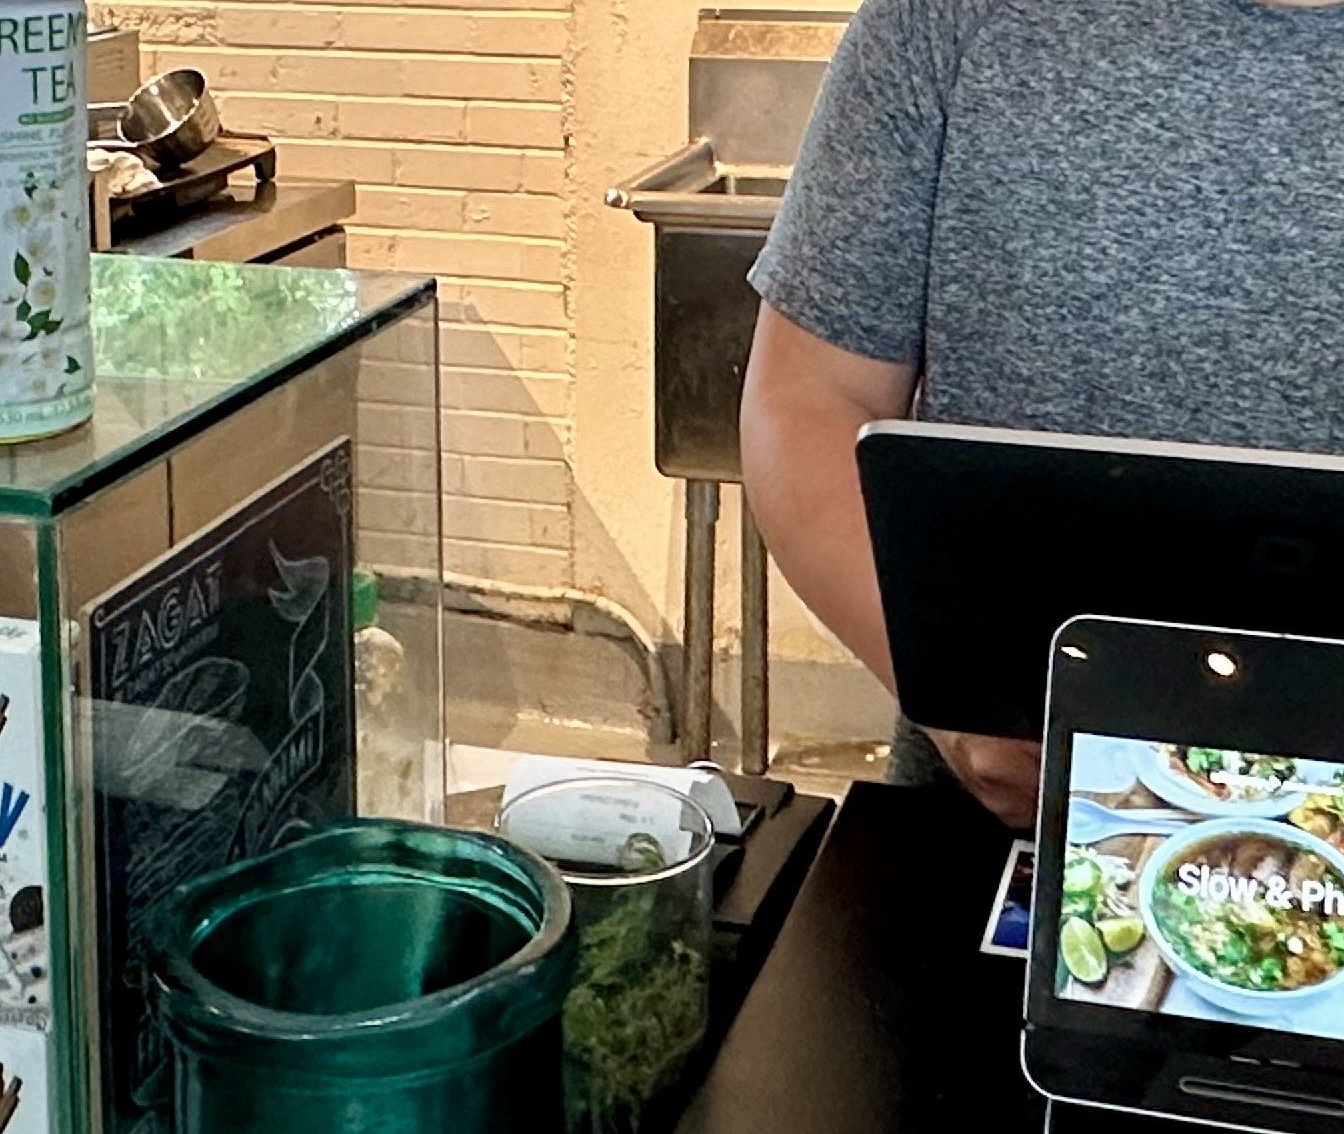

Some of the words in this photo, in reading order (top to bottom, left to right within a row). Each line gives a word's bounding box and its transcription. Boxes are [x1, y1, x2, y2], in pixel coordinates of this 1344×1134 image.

[22, 61, 76, 105] TEA
[112, 560, 224, 689] ZAGAT
[1176, 861, 1258, 904] Slow
[1263, 873, 1295, 912] &
